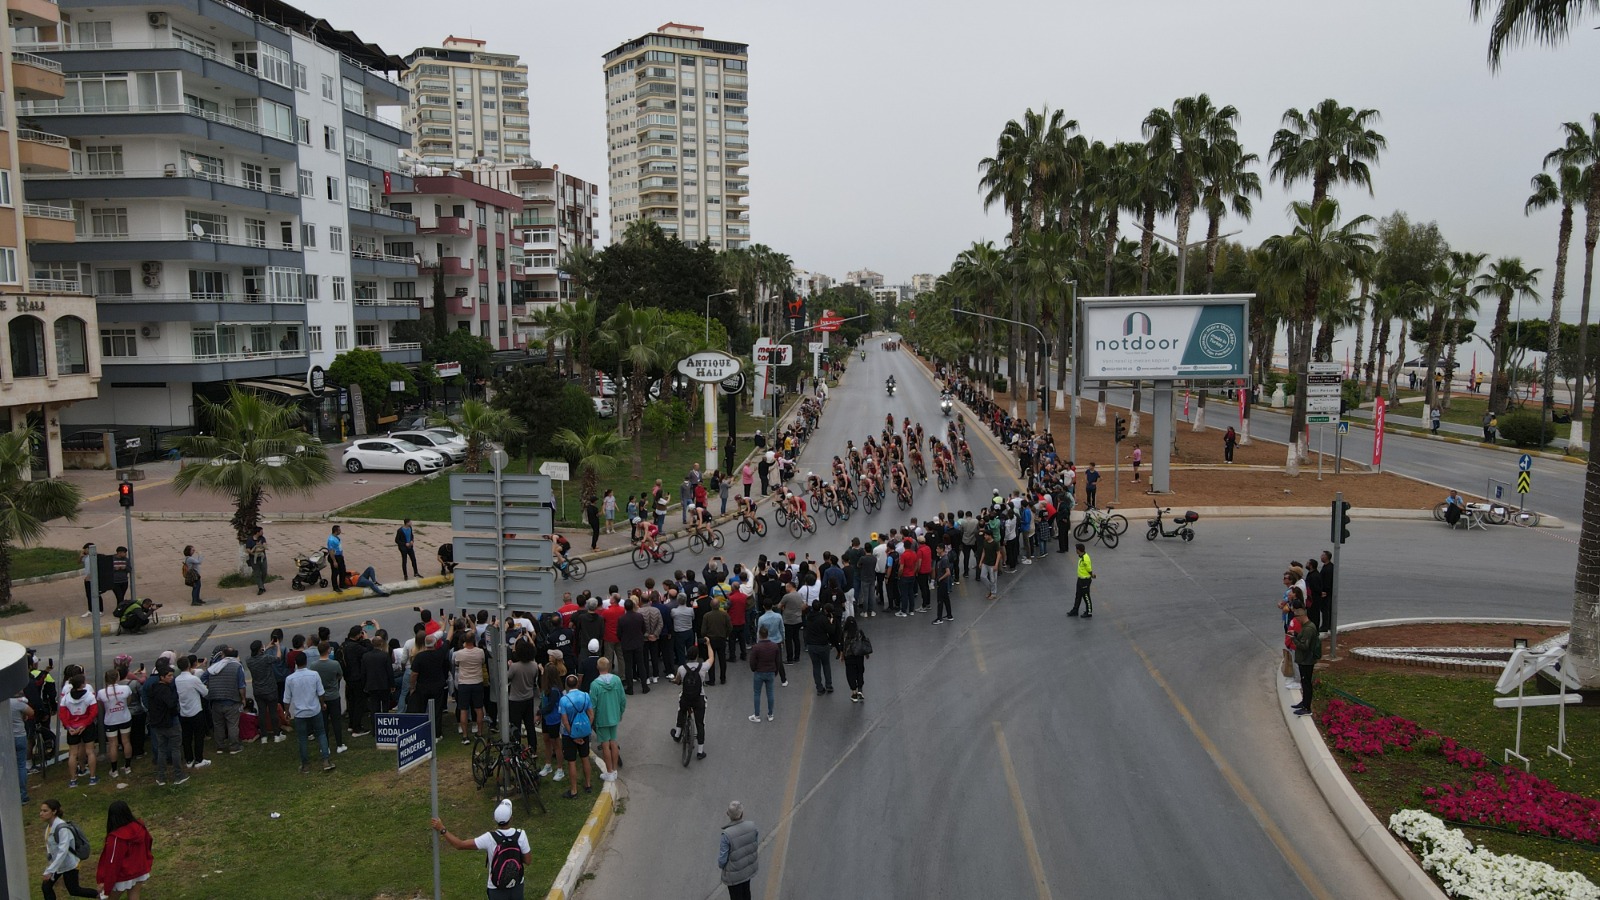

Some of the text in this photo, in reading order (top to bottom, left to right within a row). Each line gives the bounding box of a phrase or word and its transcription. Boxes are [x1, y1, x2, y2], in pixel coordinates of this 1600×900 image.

[1096, 336, 1178, 350] notdoor
[686, 358, 731, 368] ANTIQUE
[696, 368, 722, 376] HALI
[378, 716, 400, 726] NEVİT
